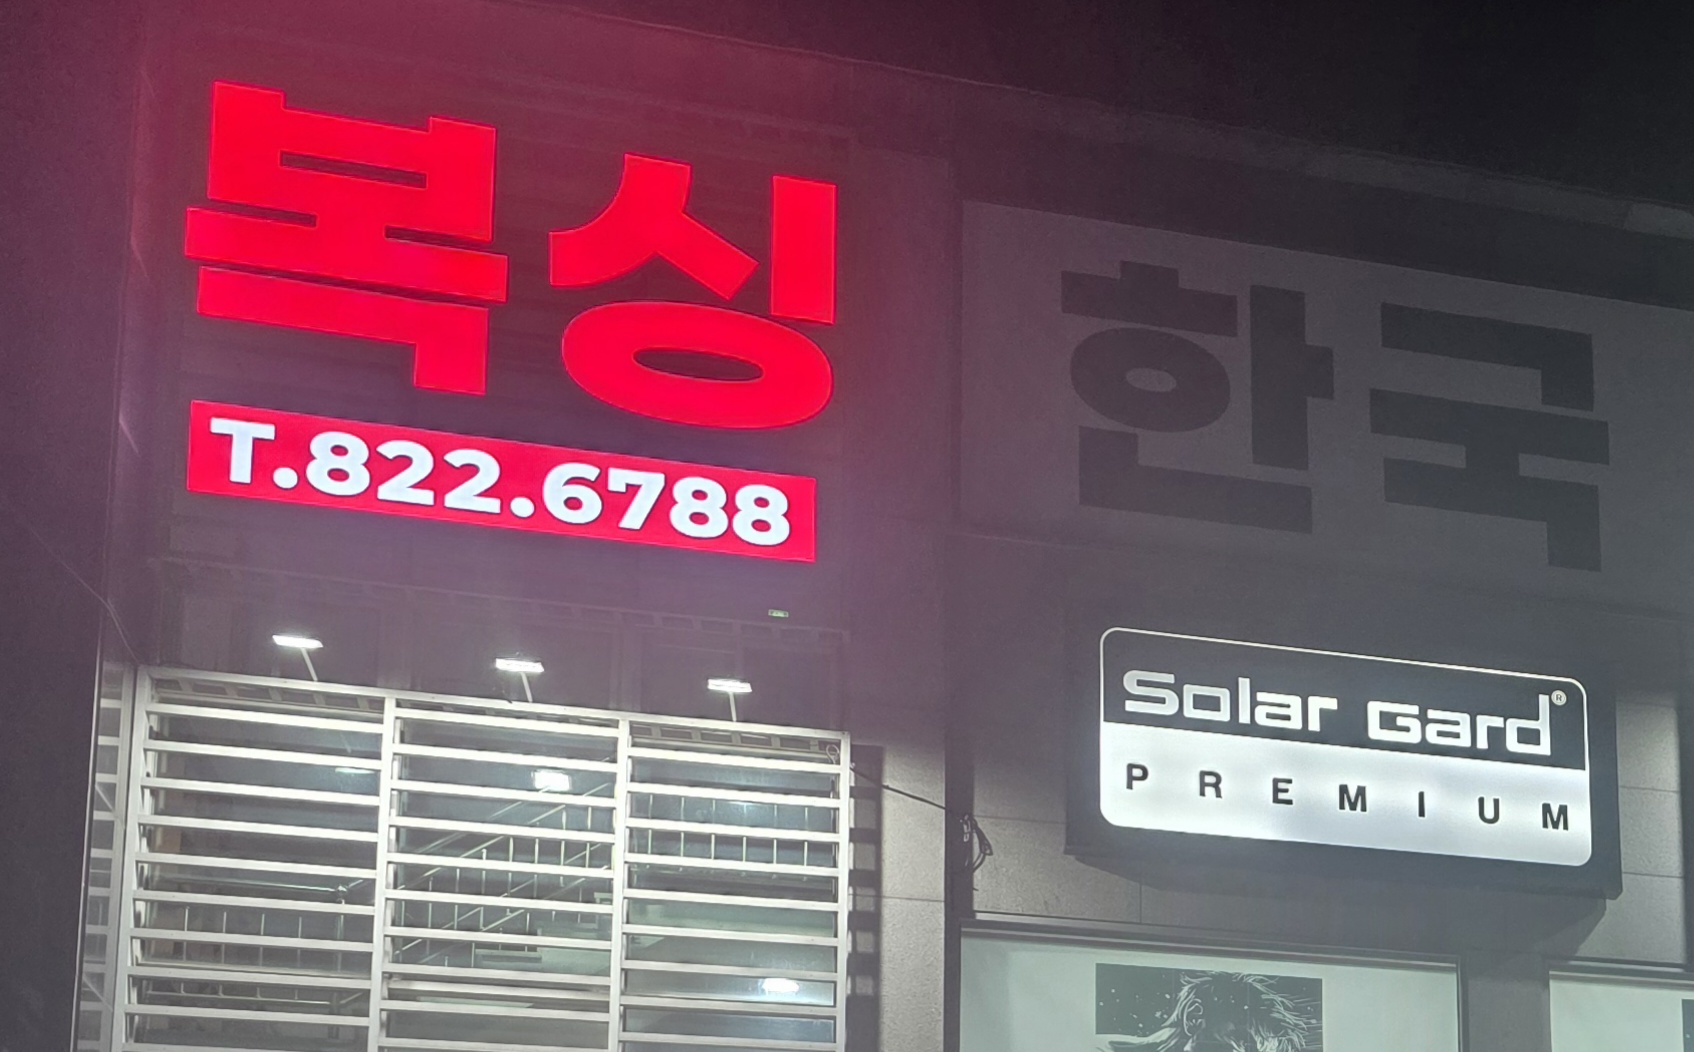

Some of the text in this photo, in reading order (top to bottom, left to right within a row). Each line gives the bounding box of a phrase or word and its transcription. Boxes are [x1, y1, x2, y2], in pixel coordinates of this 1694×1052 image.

[184, 80, 838, 429] 복싱
[1060, 259, 1611, 573] 한국
[210, 417, 791, 547] T.822.6788
[1123, 669, 1552, 756] Solar Gard
[1125, 763, 1570, 831] PREMIUM
